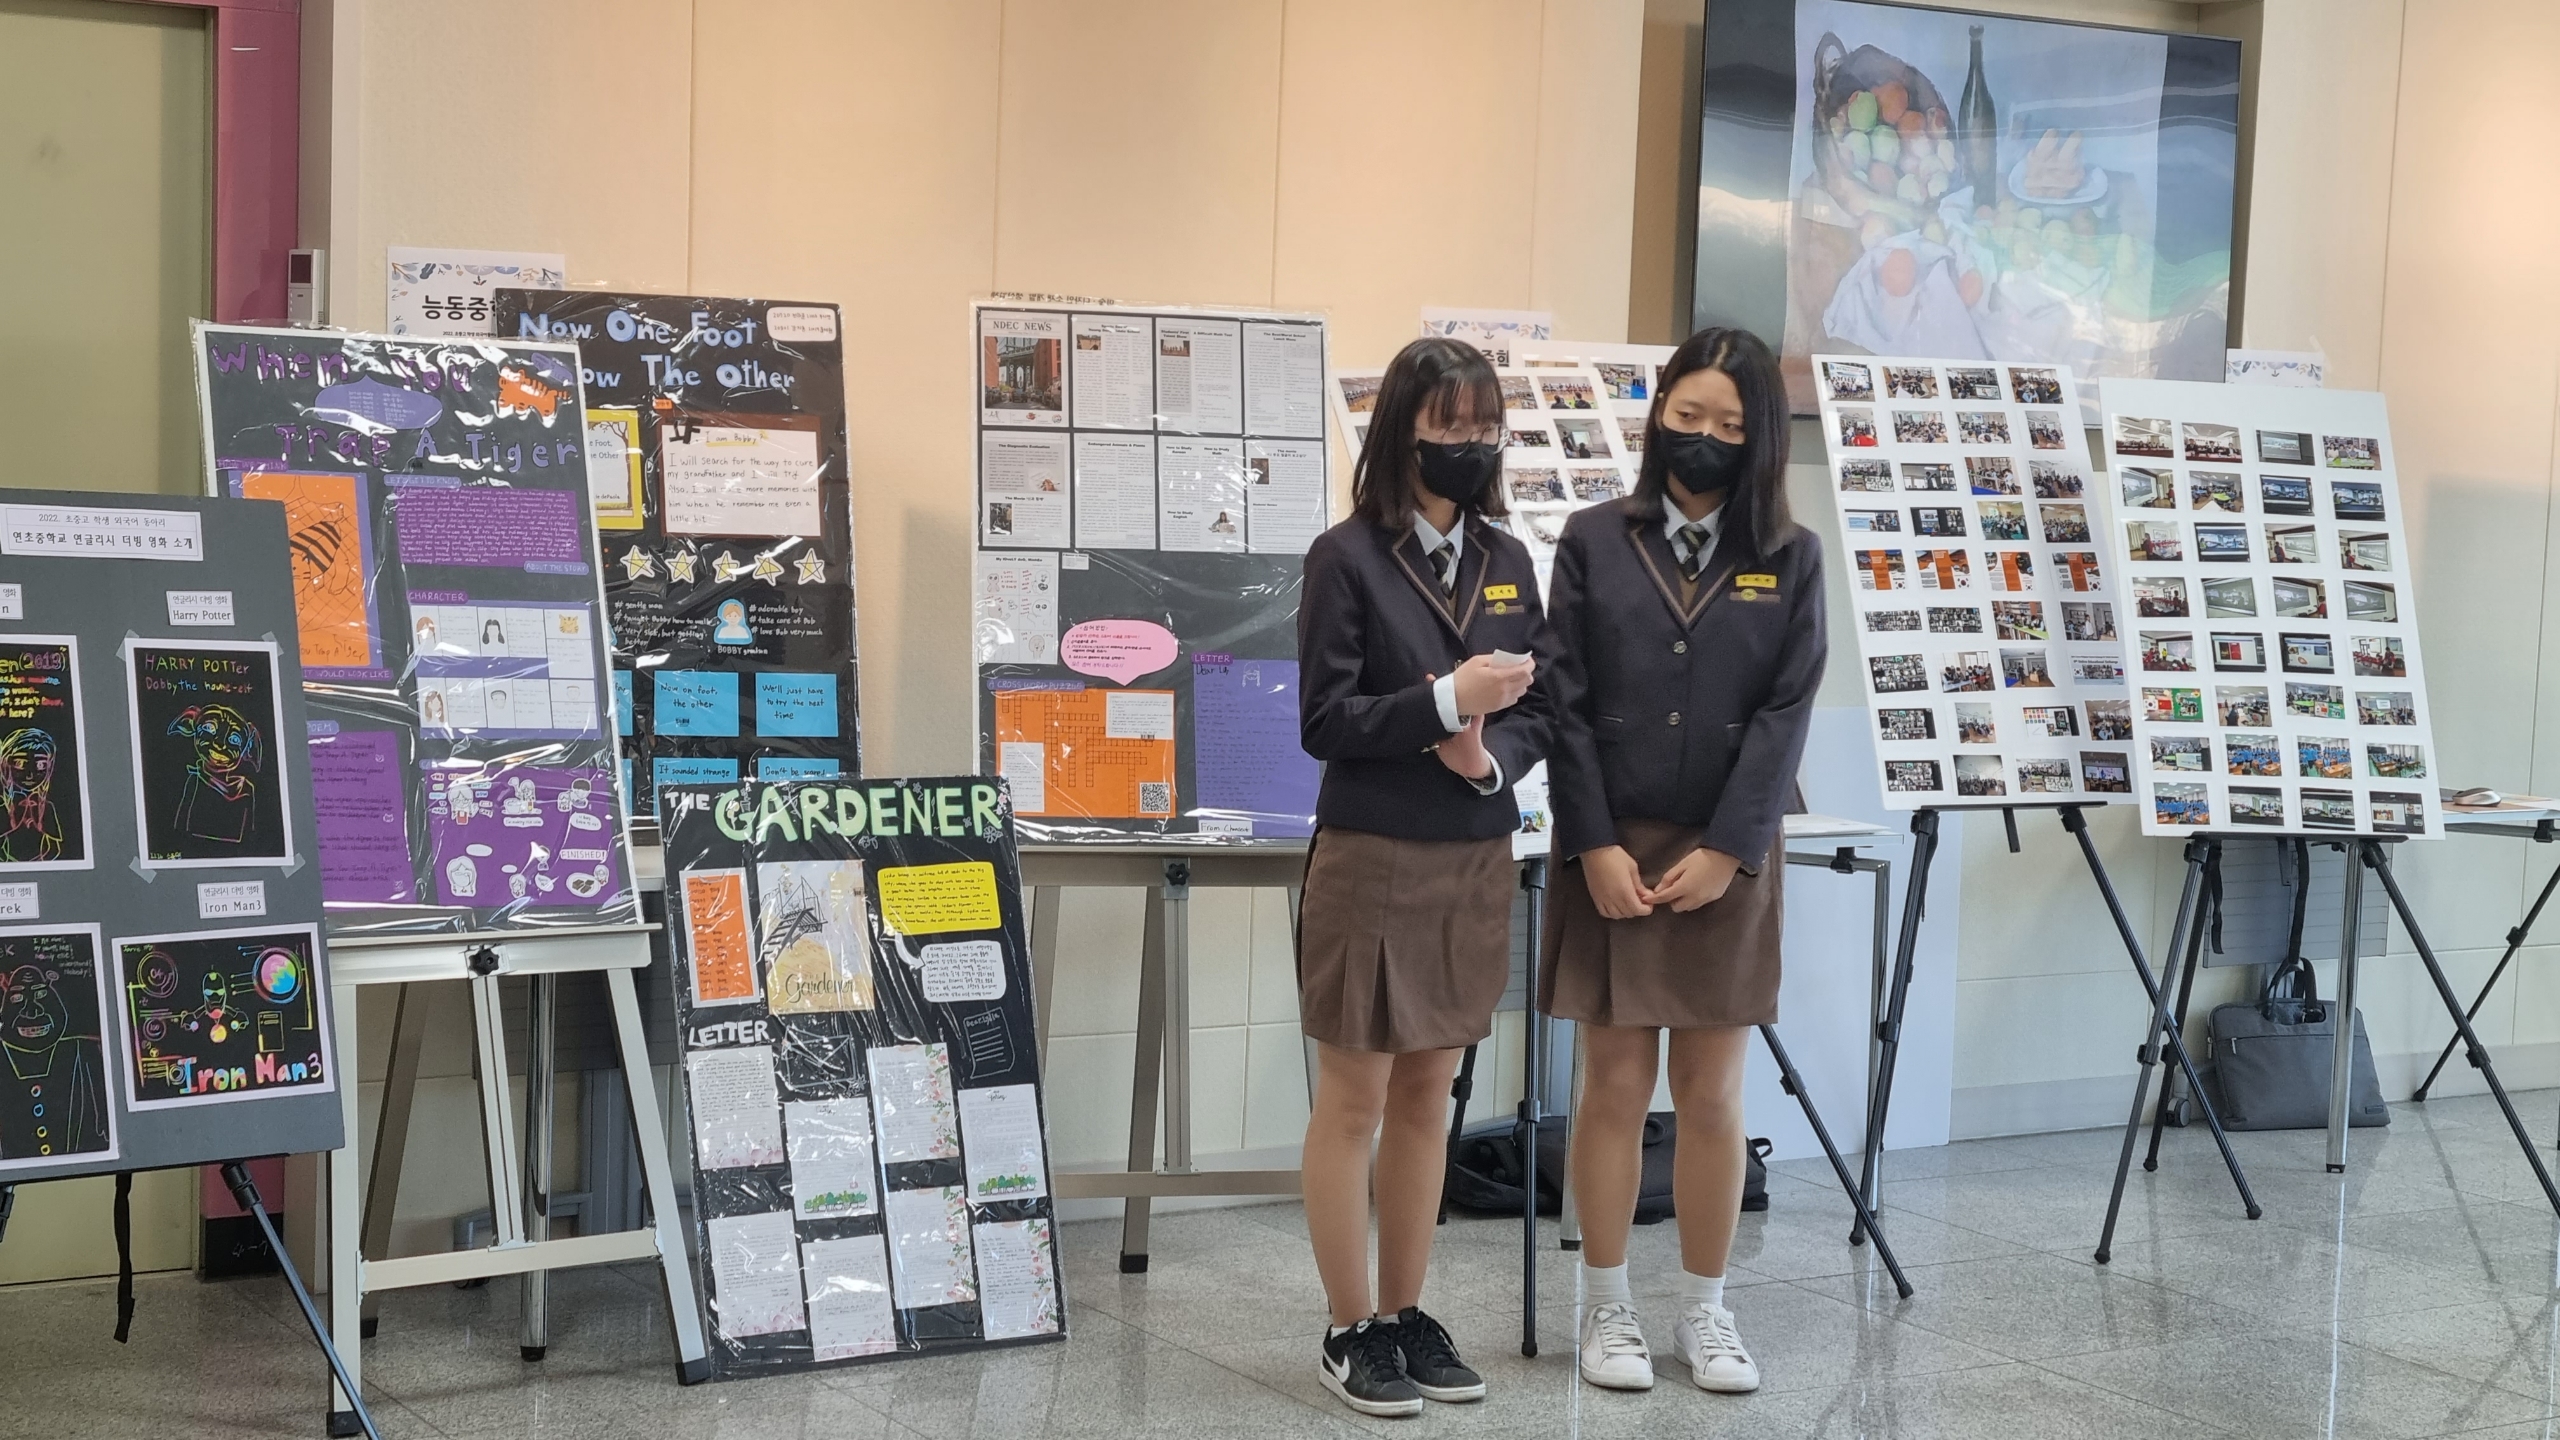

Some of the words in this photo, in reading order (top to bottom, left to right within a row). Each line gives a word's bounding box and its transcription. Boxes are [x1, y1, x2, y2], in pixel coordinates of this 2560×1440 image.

[518, 311, 592, 342] Now
[606, 309, 671, 345] One
[691, 310, 757, 346] Foot
[994, 320, 1019, 330] NDEC
[1024, 322, 1052, 332] NEWS
[211, 343, 349, 382] When
[582, 366, 622, 389] ow
[640, 353, 701, 387] The
[716, 357, 796, 391] Other
[415, 429, 439, 458] A
[465, 431, 578, 473] Tiger
[670, 453, 676, 467] I
[680, 456, 697, 466] will
[702, 456, 728, 465] search
[732, 456, 746, 465] for
[750, 457, 761, 466] the
[764, 459, 779, 467] way
[784, 458, 792, 466] to
[795, 459, 814, 467] cure
[38, 514, 61, 523] 2022.
[65, 515, 90, 524] 초중고
[94, 516, 110, 525] 학생
[114, 517, 139, 526] 외국어
[144, 518, 165, 527] 동아리
[12, 531, 67, 544] 연초중학교
[73, 533, 115, 546] 연글리시
[122, 535, 142, 547] 더빙
[148, 536, 167, 548] 영화
[174, 537, 193, 549] 소개
[526, 563, 547, 571] ABOUT
[550, 564, 562, 572] THE
[564, 564, 586, 572] STORY
[408, 592, 465, 602] CHARACTER
[173, 610, 198, 621] Harry
[202, 611, 231, 620] Potter
[791, 606, 804, 615] boy
[758, 616, 774, 624] take
[790, 629, 805, 637] very
[718, 646, 742, 654] BOBBY
[145, 653, 195, 671] HARRY
[1194, 654, 1230, 662] LETTER
[317, 670, 345, 678] WOULD
[1196, 665, 1214, 675] Dear
[145, 677, 177, 696] Dobby
[762, 685, 782, 693] We'll
[786, 687, 802, 695] just
[673, 699, 686, 708] the
[691, 699, 714, 708] other
[774, 711, 794, 719] time
[658, 765, 669, 774] It
[672, 766, 699, 775] sounded
[703, 766, 730, 778] strange
[765, 766, 787, 775] Don't
[791, 767, 799, 775] be
[664, 790, 710, 812] THE
[714, 784, 1003, 843] GARDENER
[1201, 823, 1220, 832] From
[204, 902, 228, 913] Iron
[234, 900, 262, 911] Man3
[786, 972, 854, 1003] Gardener
[688, 1021, 770, 1047] LETTER
[178, 1056, 247, 1094] Iron
[254, 1052, 322, 1085] Man3
